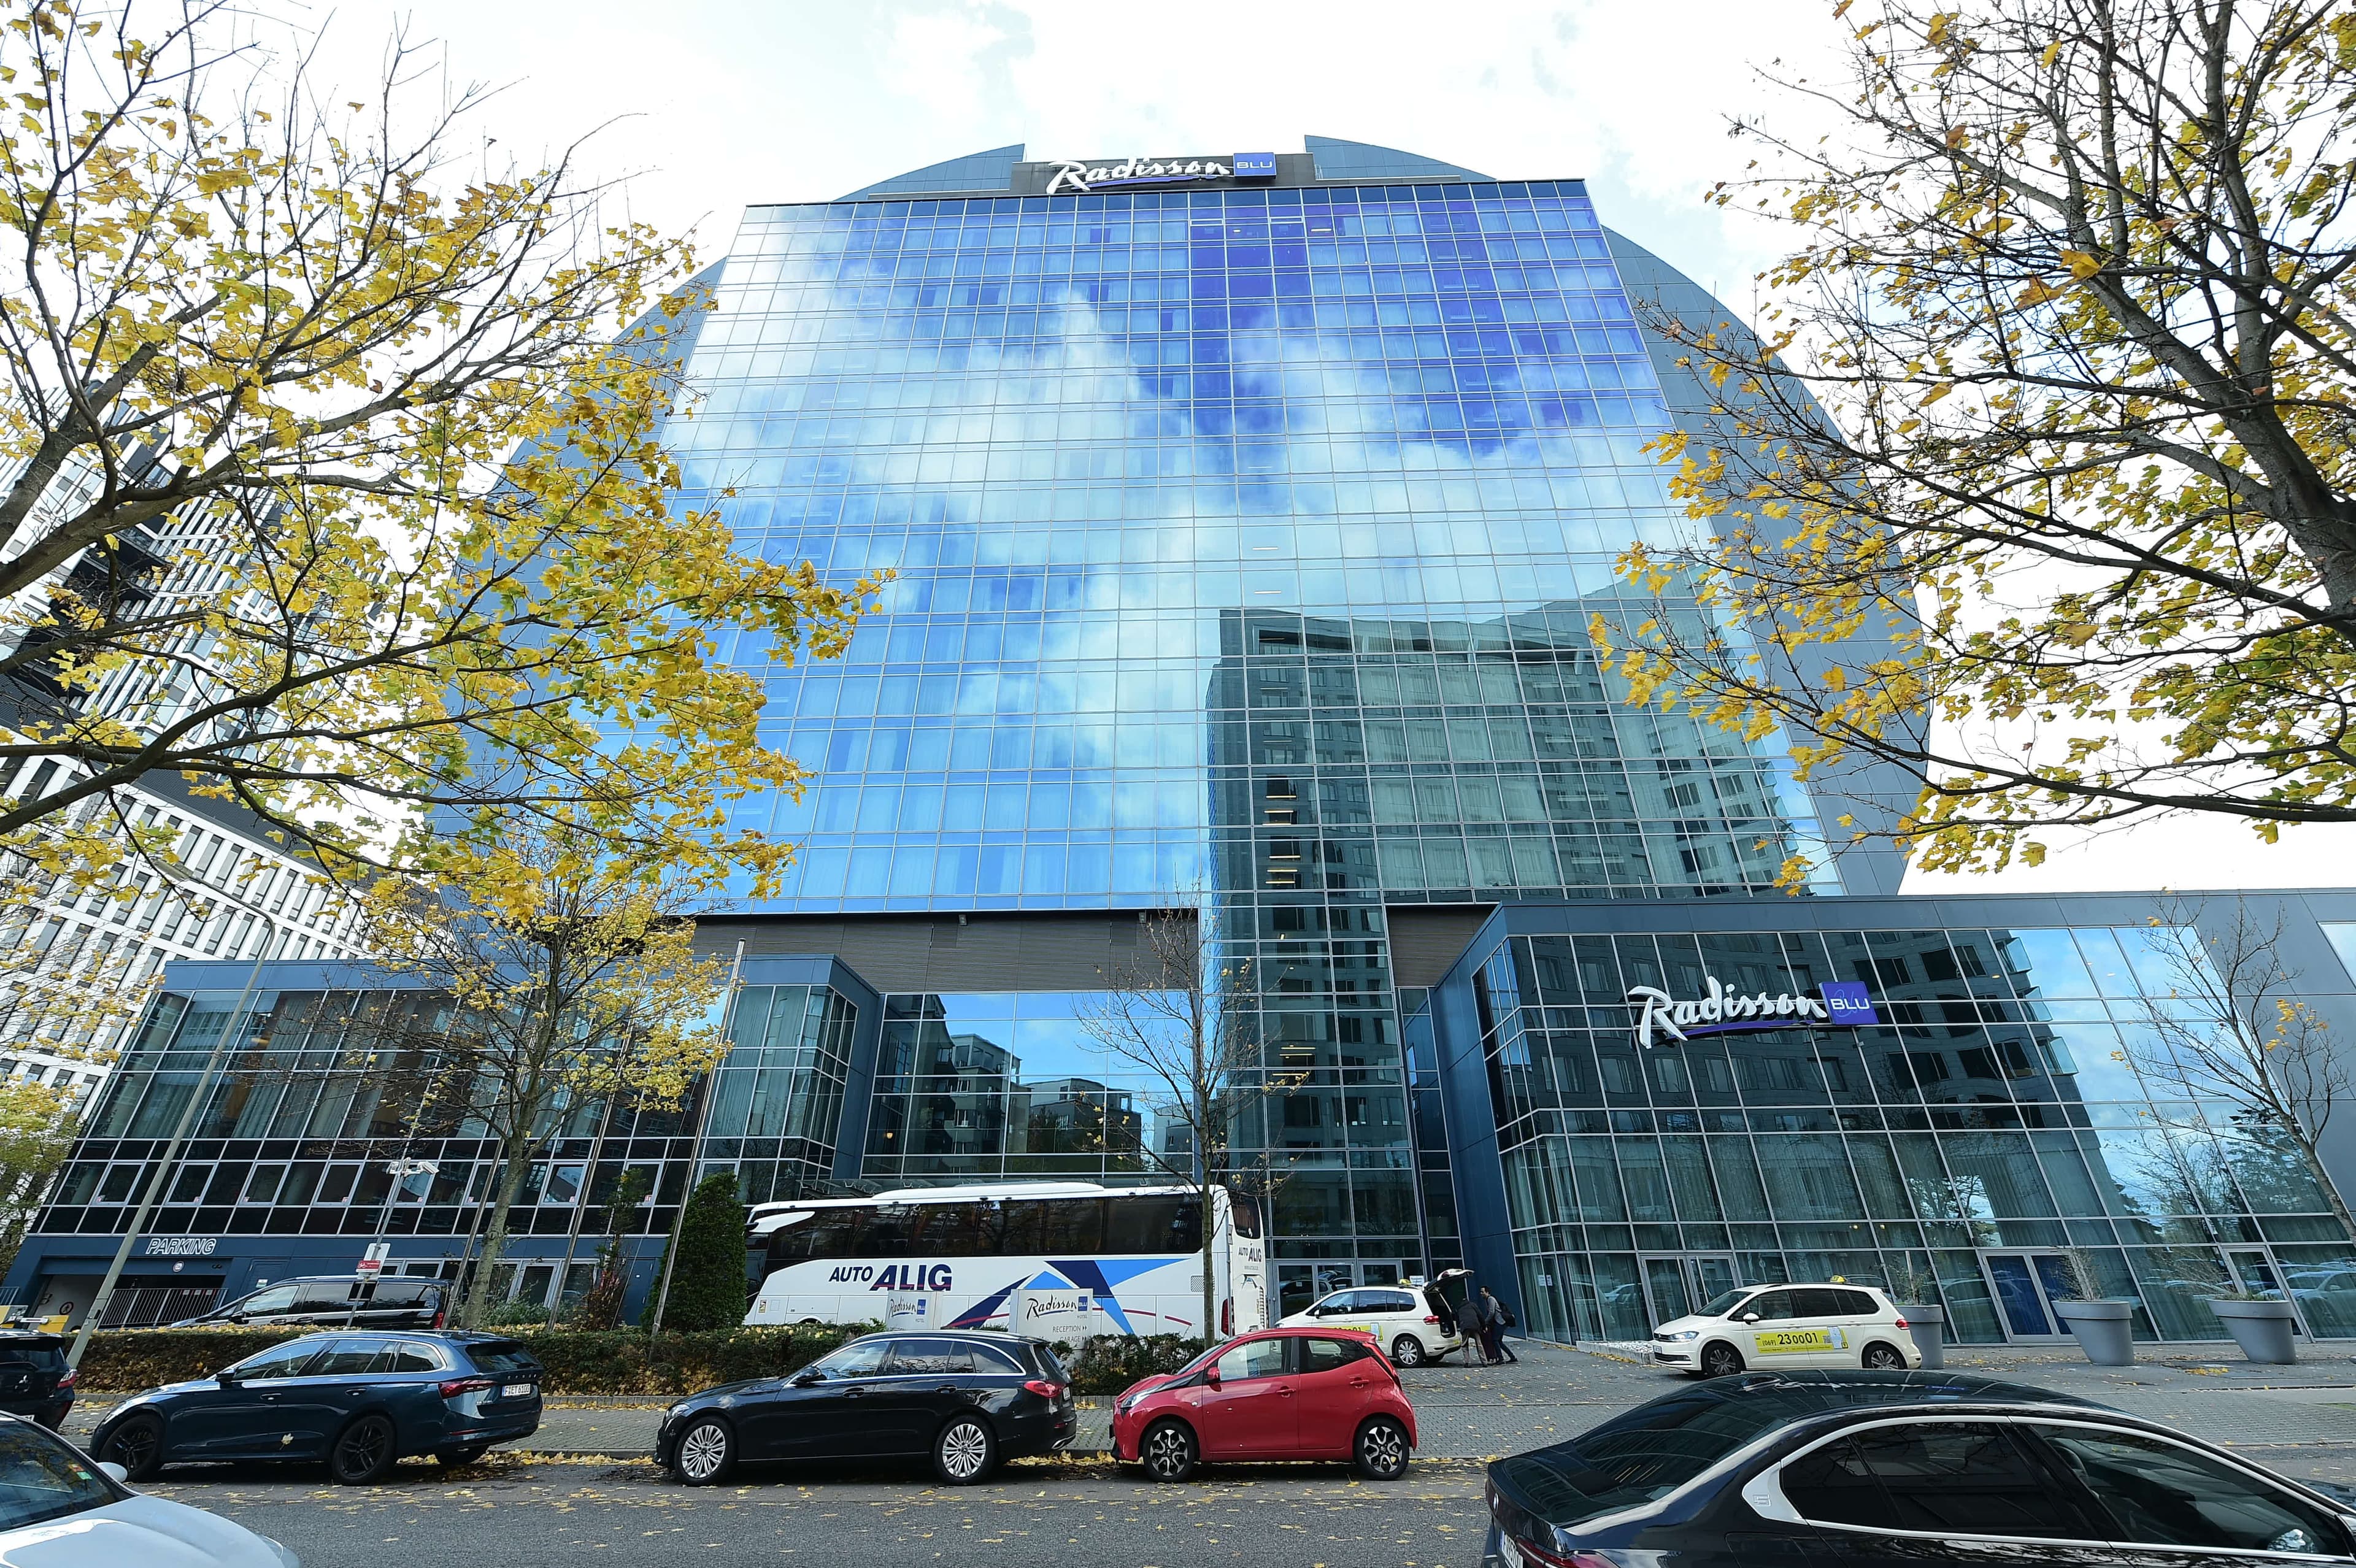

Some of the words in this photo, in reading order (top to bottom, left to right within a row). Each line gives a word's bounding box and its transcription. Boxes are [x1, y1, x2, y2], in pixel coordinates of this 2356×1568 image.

[1046, 156, 1230, 194] Radisson
[1627, 975, 1828, 1049] Radisson
[1831, 998, 1870, 1010] BLU
[145, 1238, 217, 1255] PARKING
[1239, 1247, 1248, 1256] AUTO
[1249, 1247, 1261, 1262] ALIG
[828, 1266, 873, 1282] AUTO
[869, 1264, 952, 1291] ALIG
[888, 1296, 916, 1320] Radisson
[1026, 1294, 1077, 1320] Radisson
[1777, 1332, 1818, 1345] 230001
